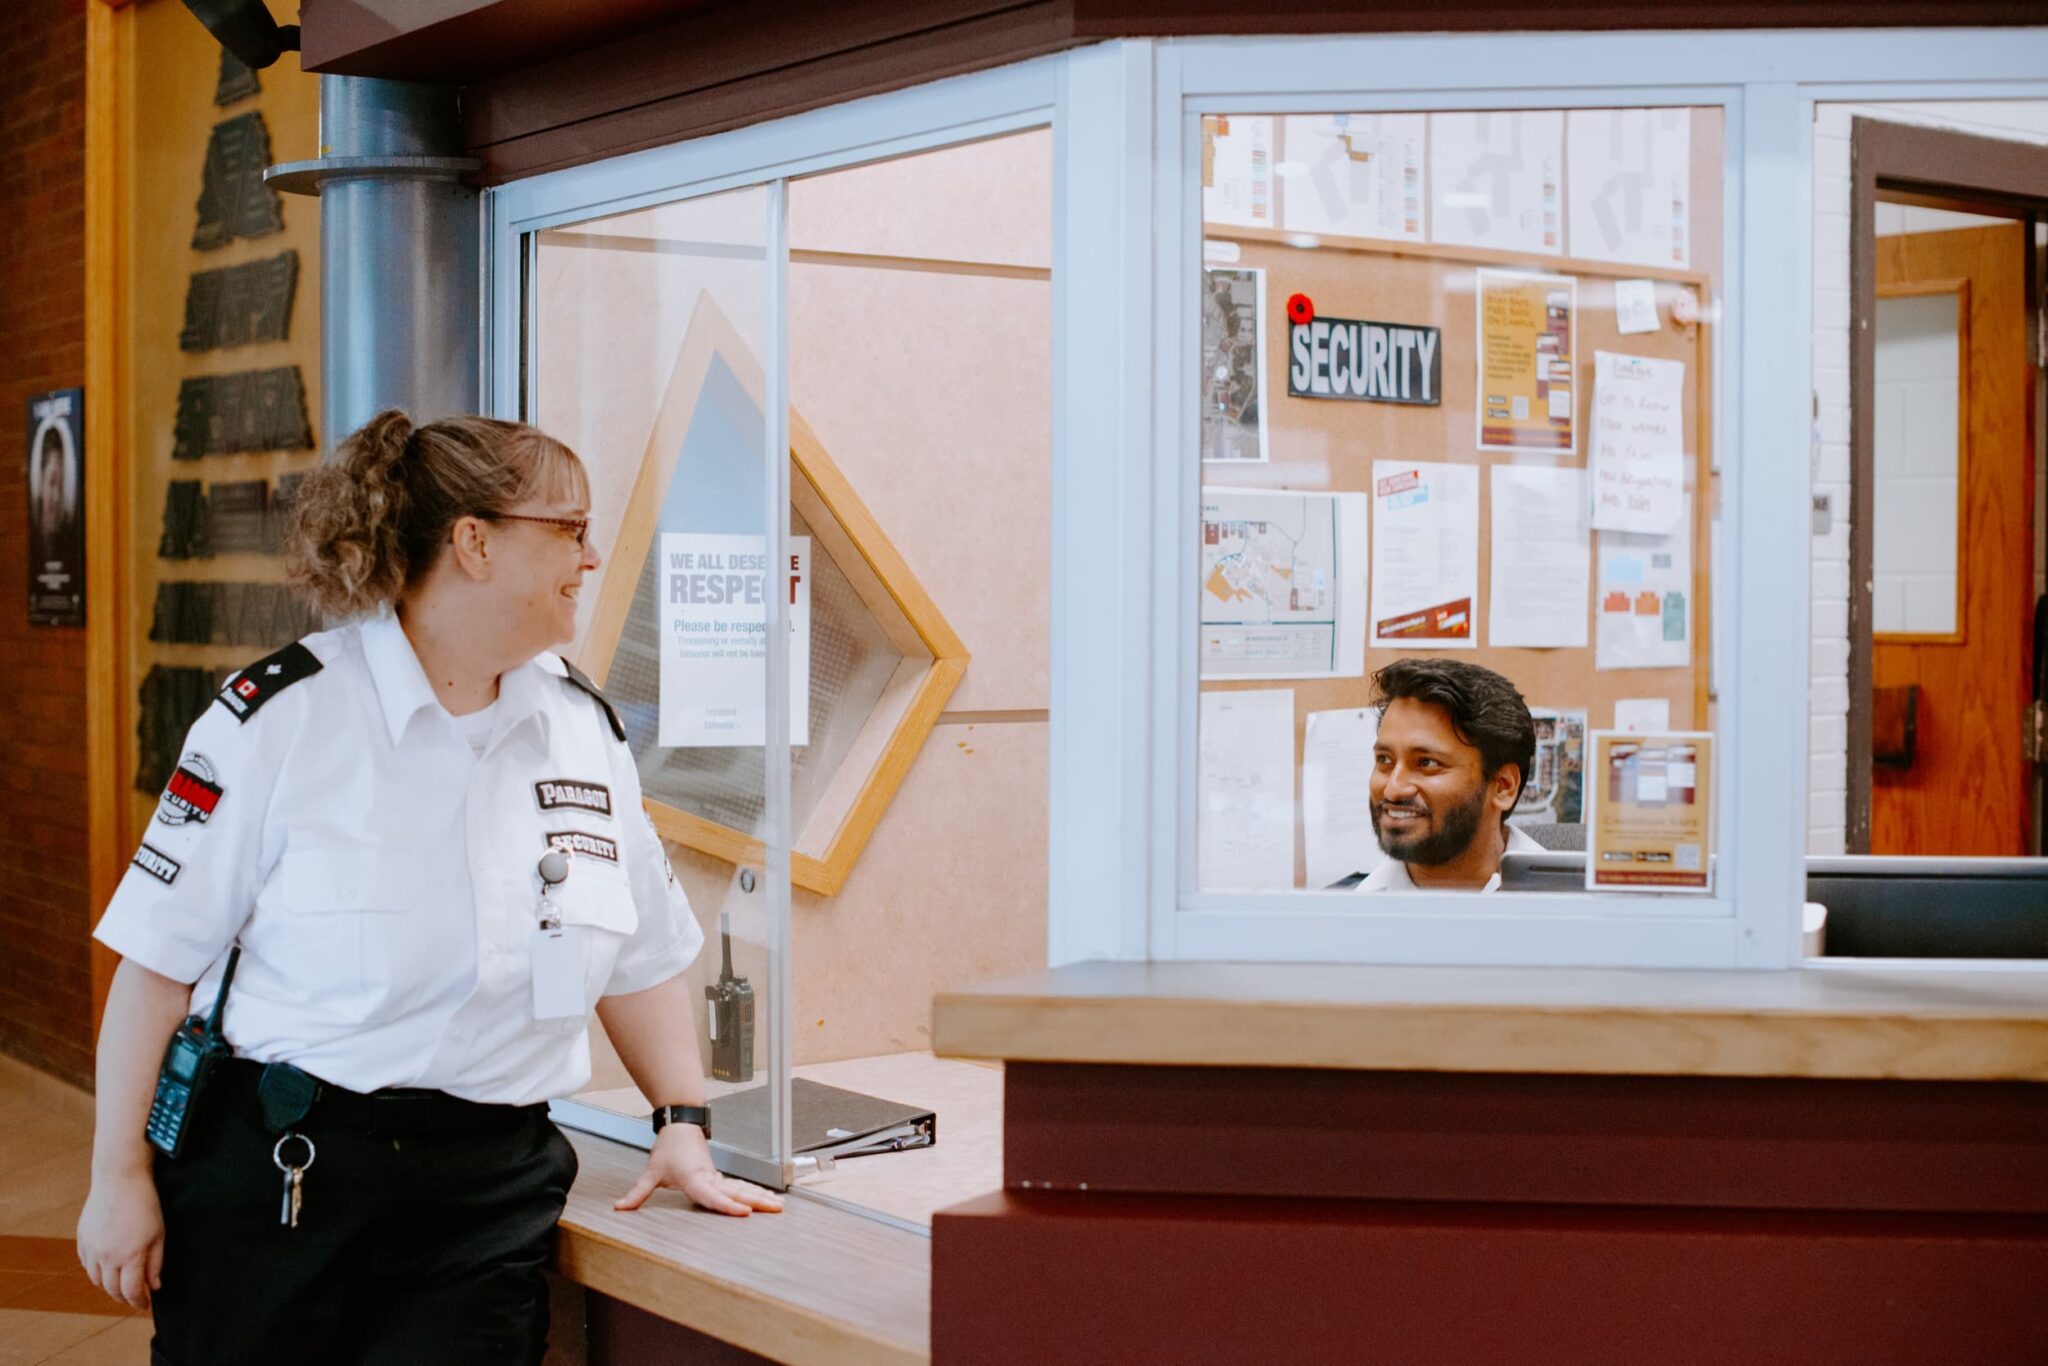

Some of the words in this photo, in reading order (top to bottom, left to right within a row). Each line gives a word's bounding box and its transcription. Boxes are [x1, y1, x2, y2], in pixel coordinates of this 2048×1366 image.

[1292, 321, 1437, 400] SECURITY
[670, 553, 693, 569] WE
[697, 554, 724, 570] ALL
[729, 554, 799, 571] DESEE
[673, 619, 711, 632] Please
[714, 620, 728, 632] be
[540, 783, 608, 810] PARAGON
[551, 835, 615, 858] SECURITY
